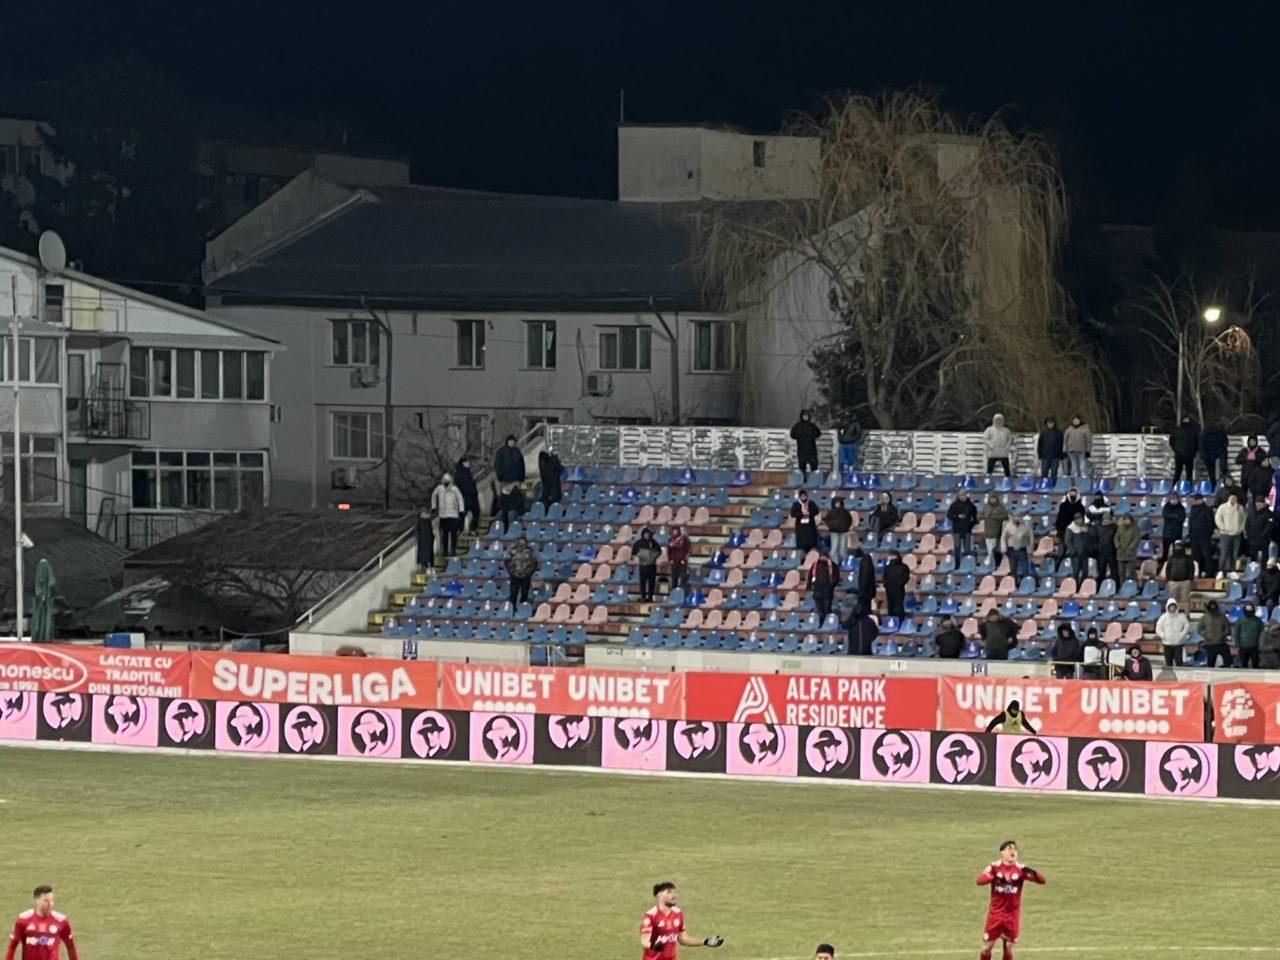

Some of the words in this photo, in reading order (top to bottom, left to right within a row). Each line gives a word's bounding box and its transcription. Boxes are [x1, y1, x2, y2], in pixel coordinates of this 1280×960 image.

[100, 654, 151, 668] LACTATE
[154, 657, 172, 669] CU
[88, 683, 110, 694] DIN
[212, 658, 417, 705] SUPERLIGA
[455, 670, 554, 699] UNIBET
[568, 674, 669, 704] UNIBET
[786, 677, 831, 701] ALFA
[838, 679, 886, 702] PARK
[1080, 687, 1190, 716] UNIBET
[786, 704, 886, 728] RESIDENCE
